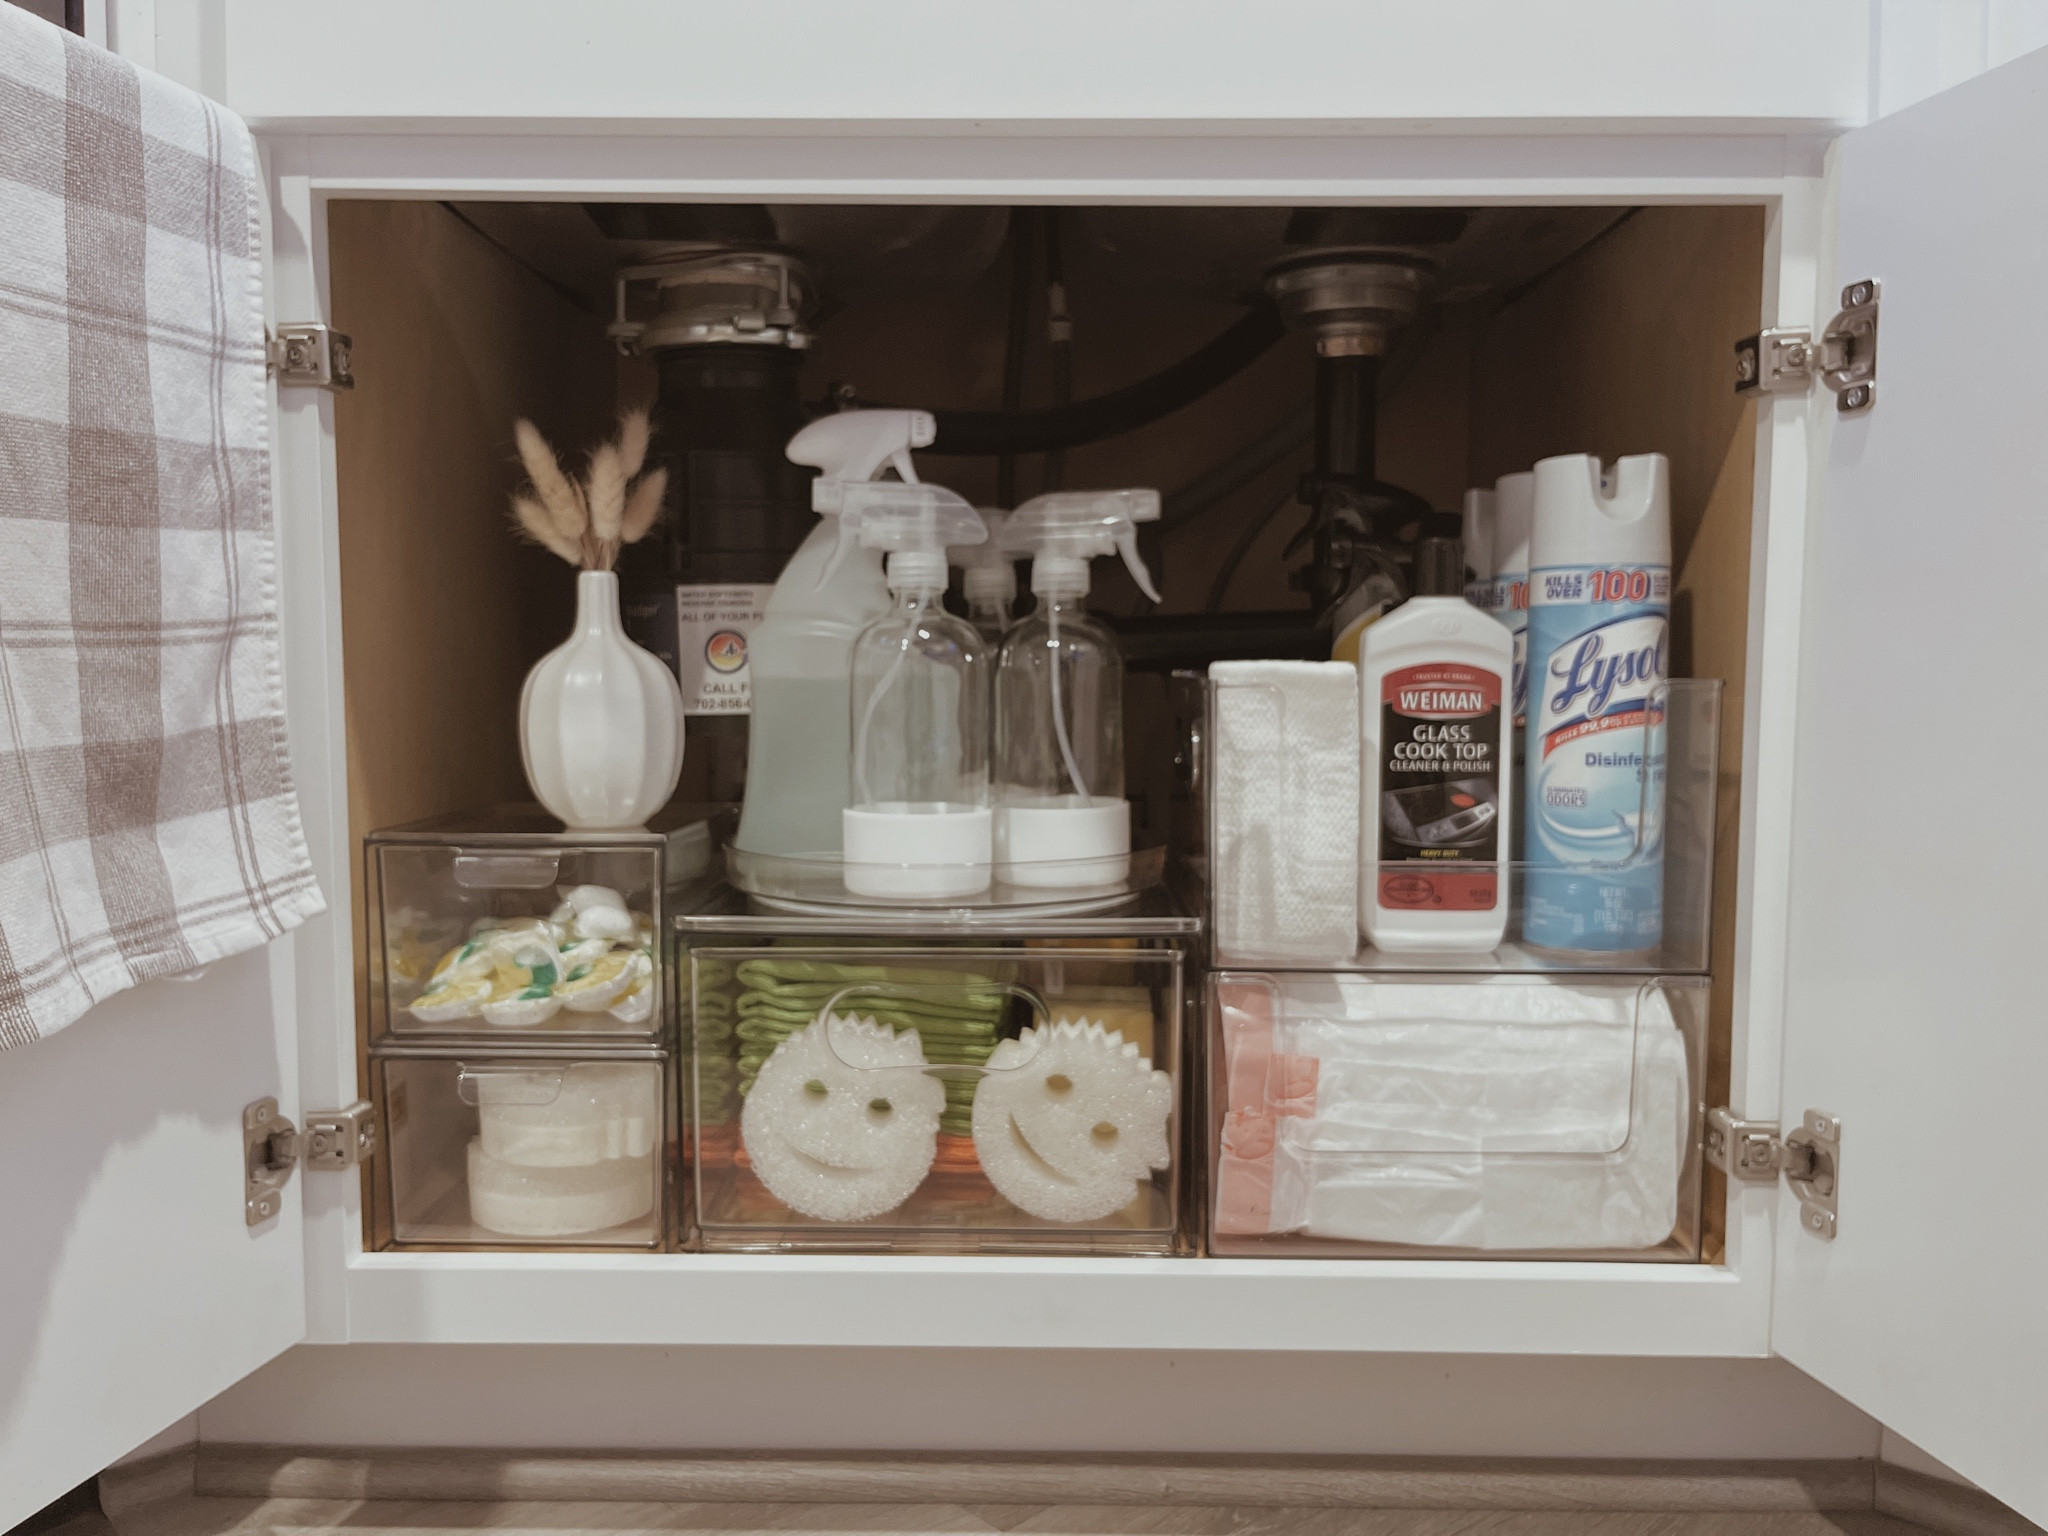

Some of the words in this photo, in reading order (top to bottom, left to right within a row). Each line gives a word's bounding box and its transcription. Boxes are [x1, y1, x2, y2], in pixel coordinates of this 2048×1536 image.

[1545, 574, 1583, 587] KILLS
[1588, 569, 1650, 602] 100
[1546, 586, 1582, 598] OVER
[682, 613, 698, 622] ALL
[703, 612, 717, 622] OF
[720, 612, 750, 622] YOUR
[1551, 624, 1667, 717] Lysol
[703, 682, 738, 694] CALL
[1400, 691, 1481, 711] WEIMAN
[1413, 725, 1470, 742] GLASS
[1394, 742, 1448, 760] COOK
[1453, 742, 1487, 760] TOP
[1389, 760, 1438, 772] CLEANER
[1453, 760, 1490, 772] POLISH
[1546, 793, 1587, 807] ODORS
[1420, 849, 1441, 857] HEAVY
[1442, 849, 1459, 857] DUTY
